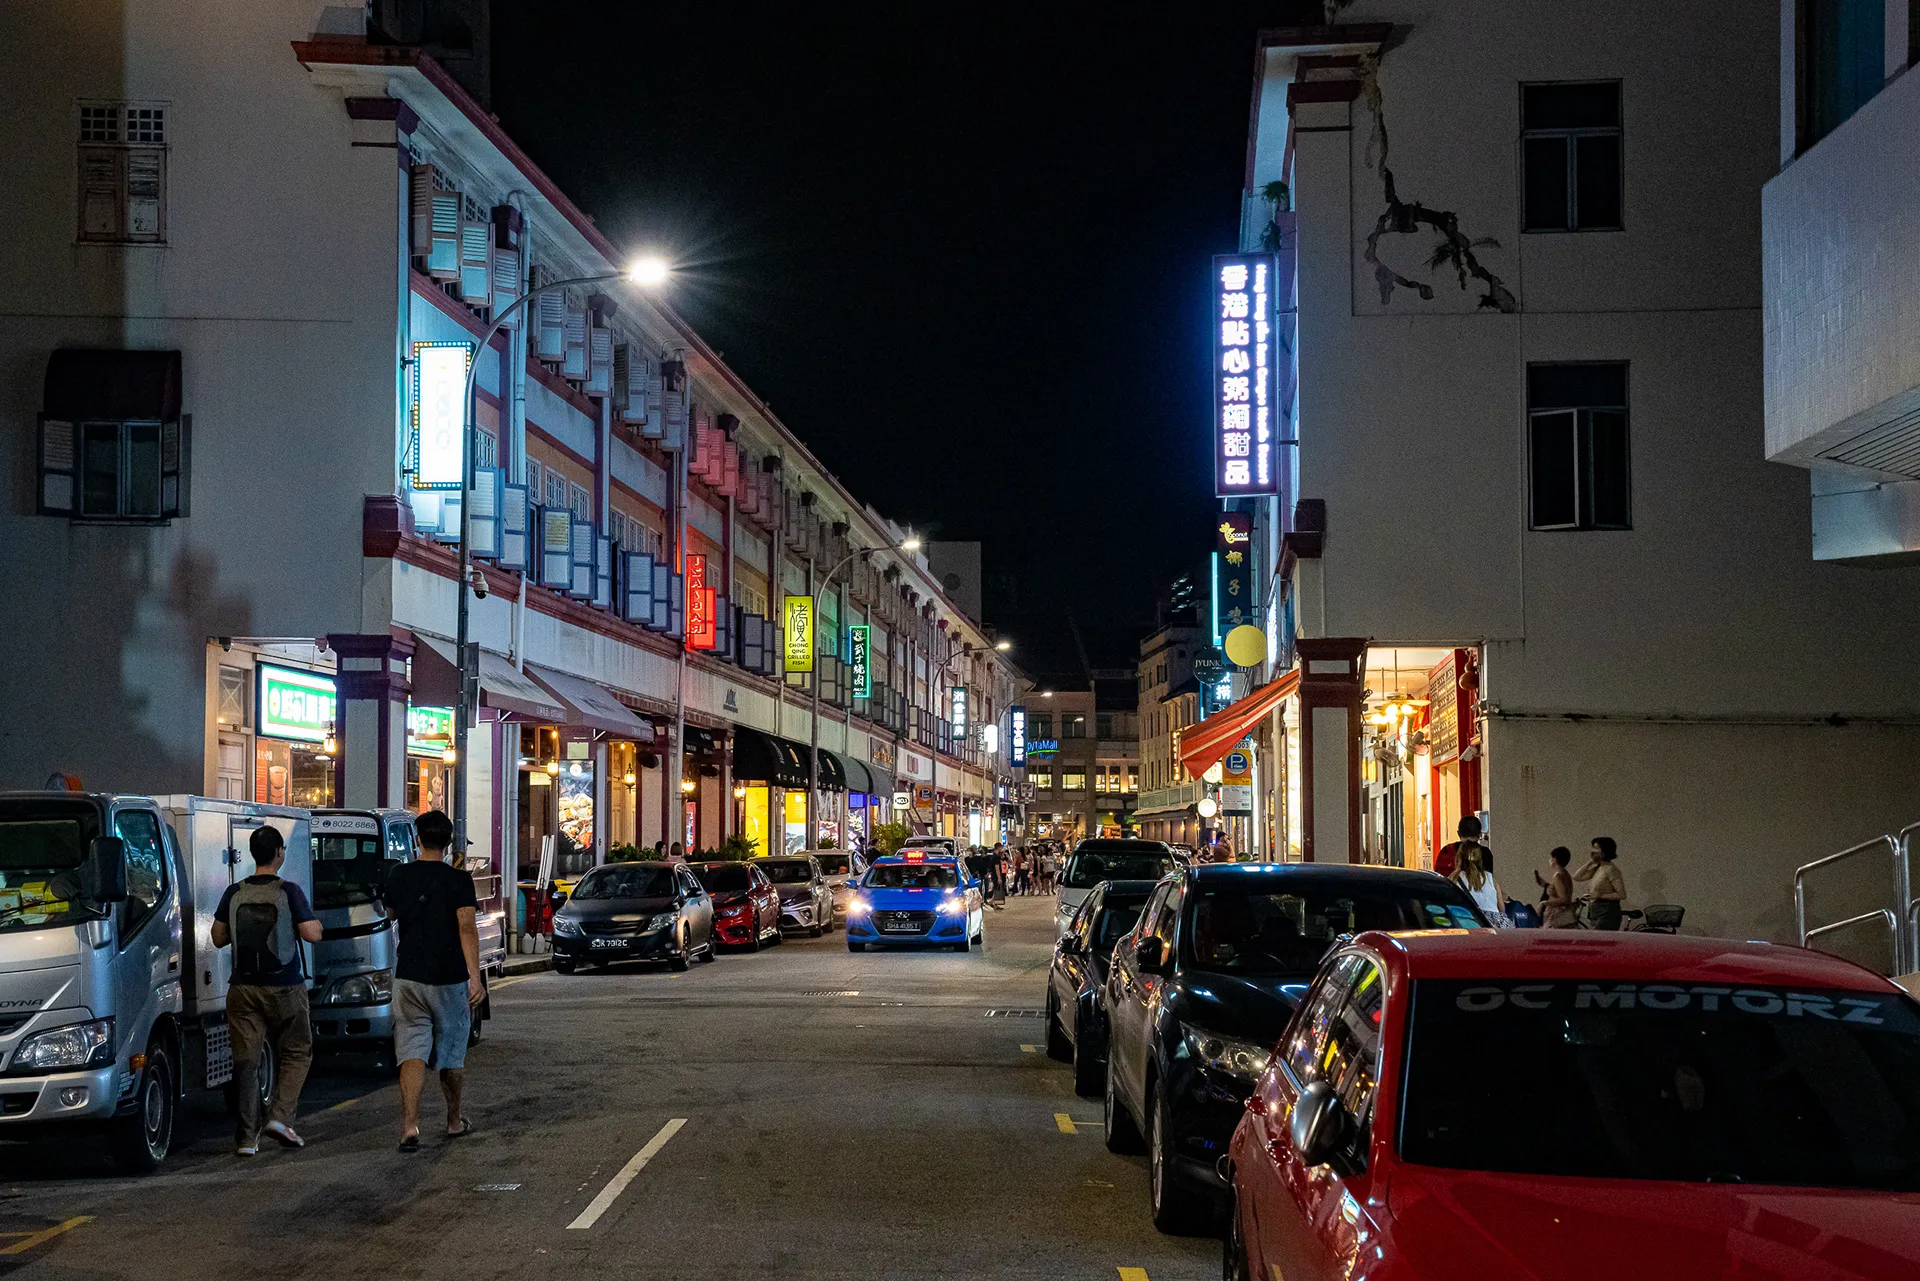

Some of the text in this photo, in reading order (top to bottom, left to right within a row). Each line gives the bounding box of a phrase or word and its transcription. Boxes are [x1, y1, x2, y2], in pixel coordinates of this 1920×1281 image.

[332, 820, 354, 828] 8022
[355, 821, 376, 829] 6868
[0, 998, 43, 1008] DYNA
[1456, 984, 1886, 1025] OC MOTORZ
